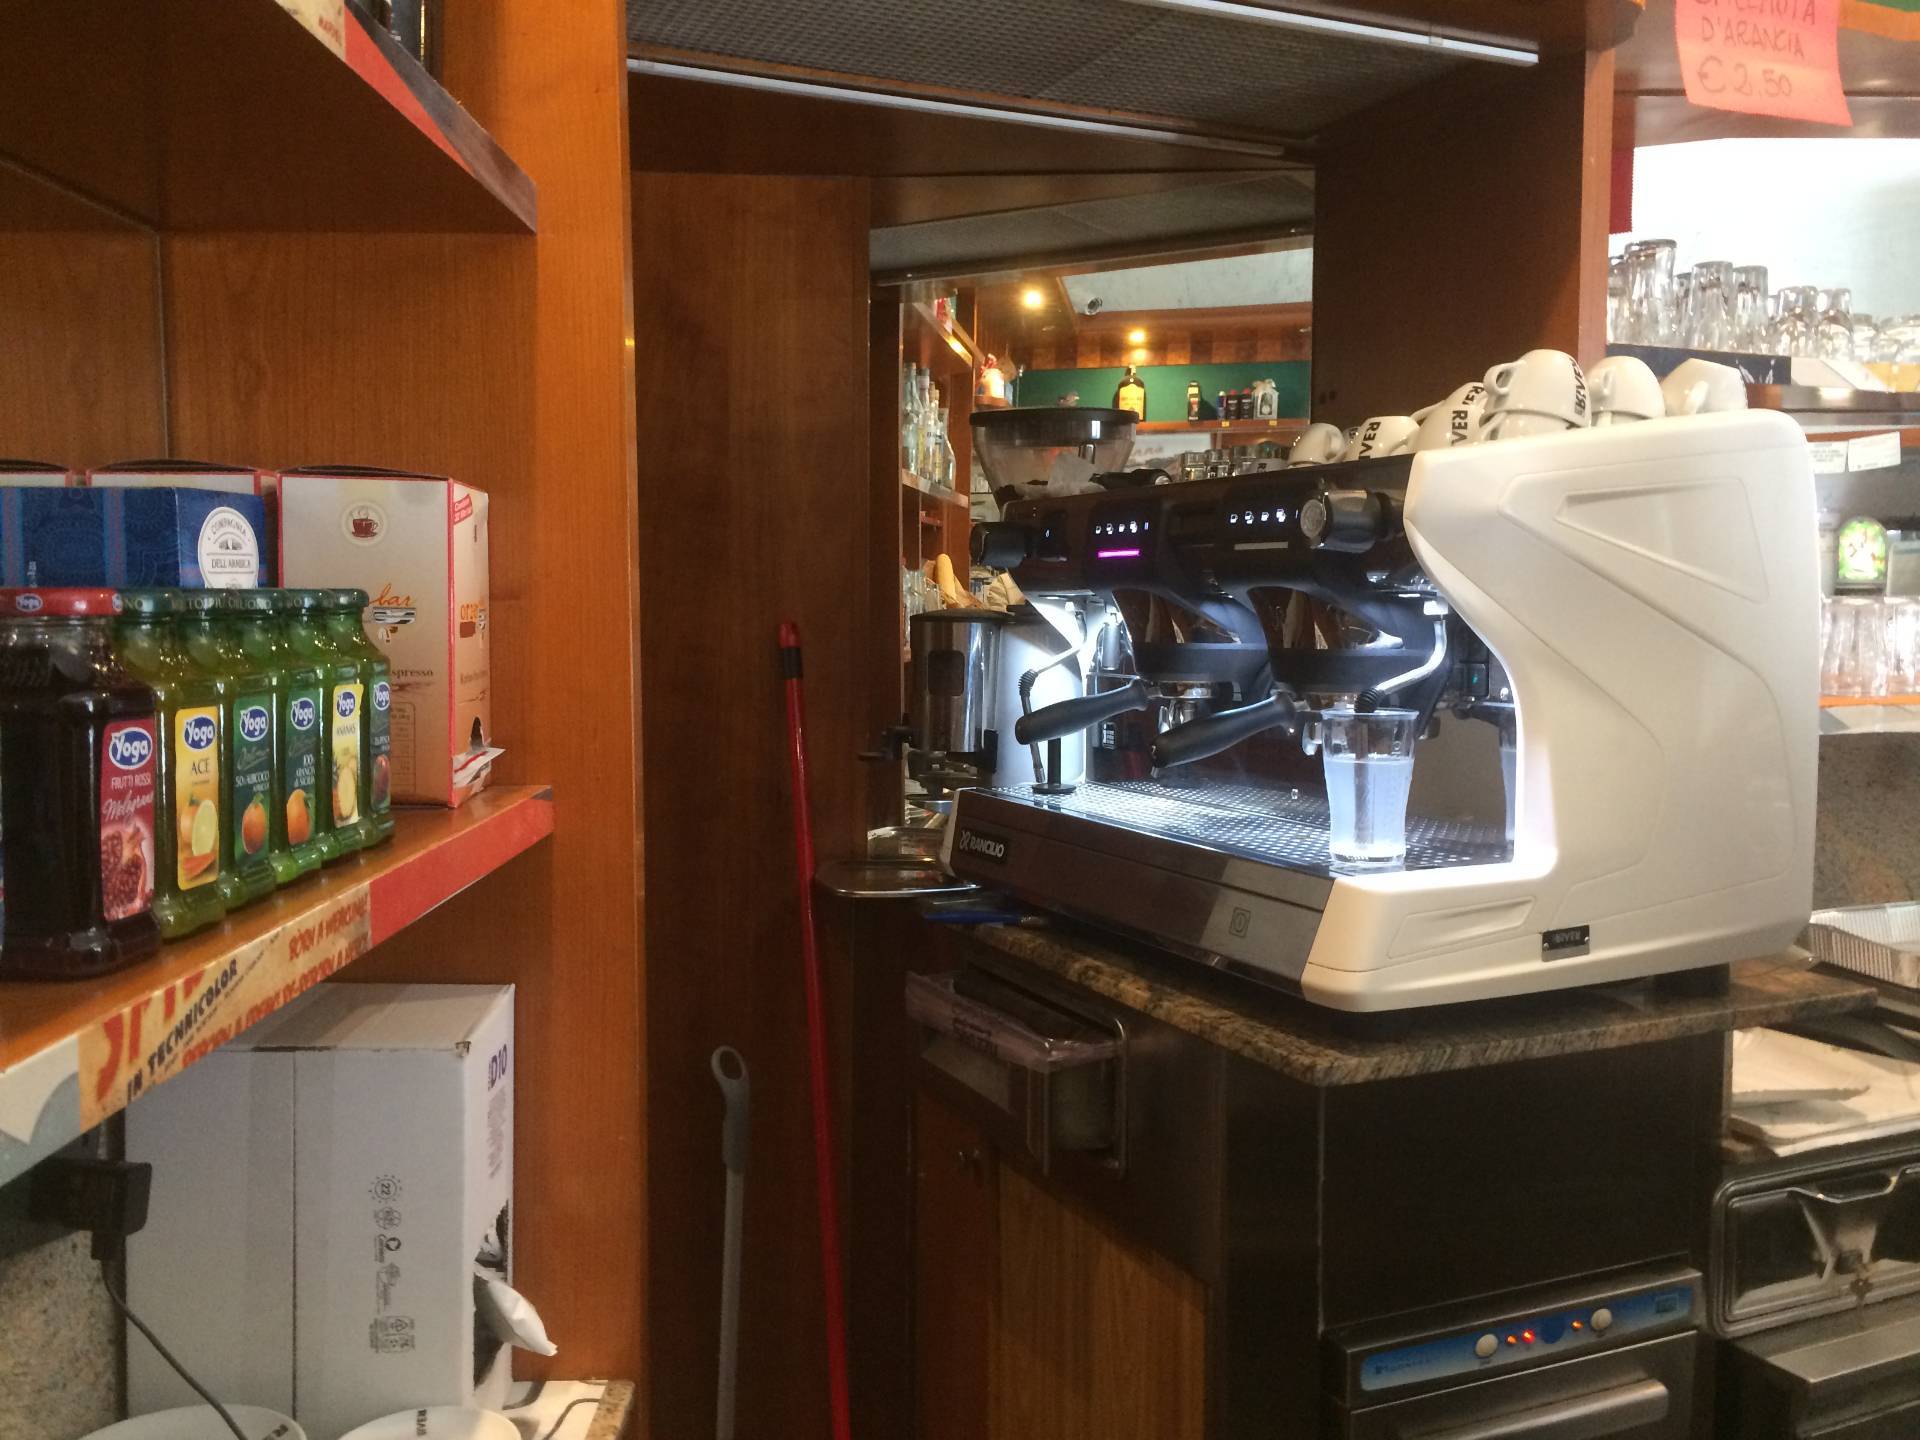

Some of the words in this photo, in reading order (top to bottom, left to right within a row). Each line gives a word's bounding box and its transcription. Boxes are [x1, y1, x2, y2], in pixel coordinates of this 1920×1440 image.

[391, 669, 434, 679] spresso
[291, 702, 313, 726] Yoga
[337, 691, 355, 715] Yoga
[186, 718, 214, 747] Yoga
[241, 711, 266, 736] Yoga
[112, 733, 149, 764] Yoga
[191, 758, 209, 775] ACE
[126, 1068, 143, 1102] IN
[147, 957, 238, 1077] TECHNICOLOR
